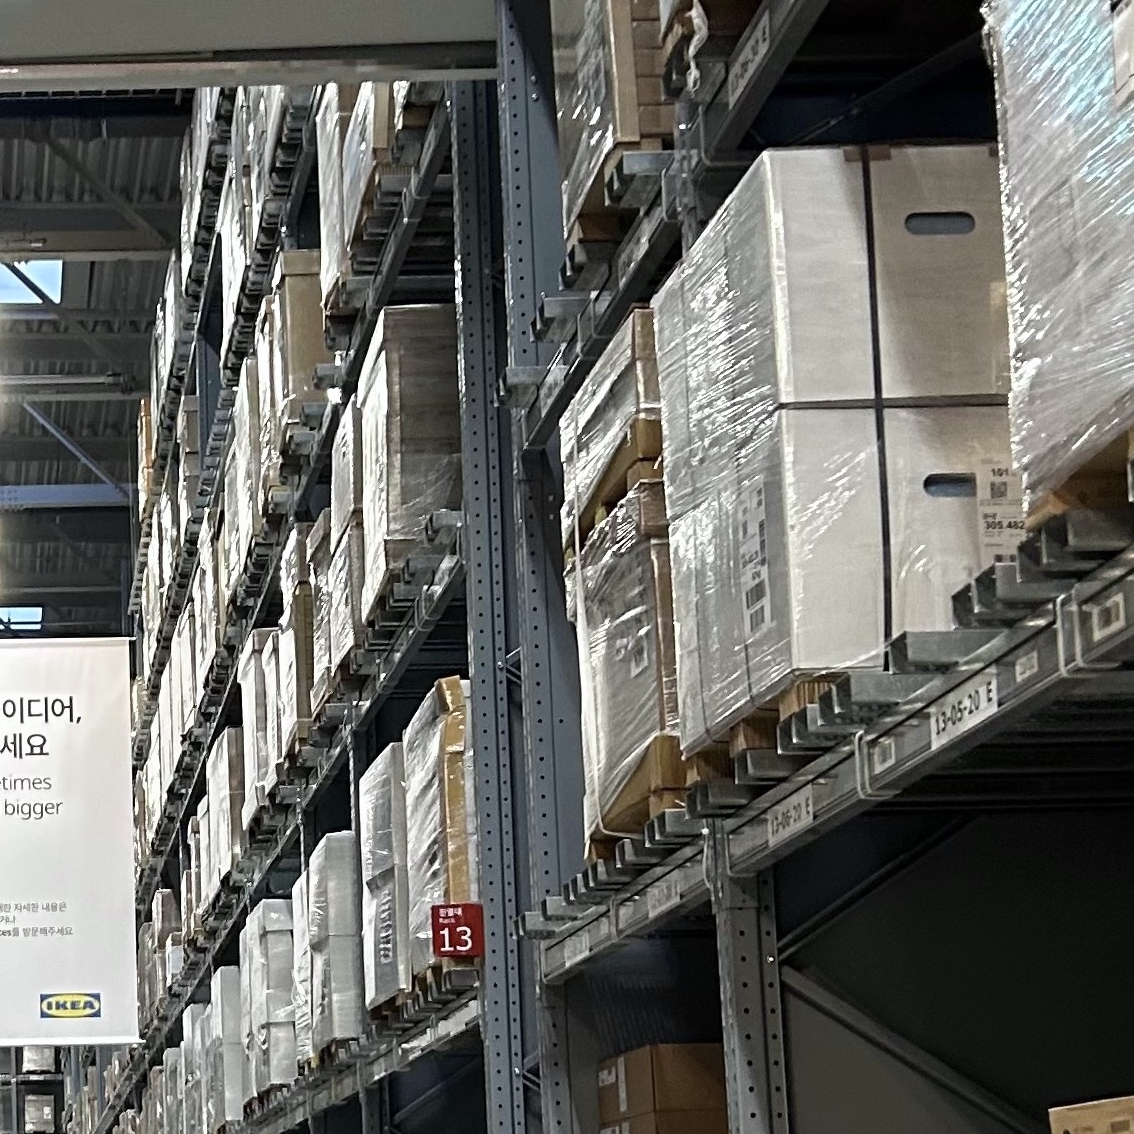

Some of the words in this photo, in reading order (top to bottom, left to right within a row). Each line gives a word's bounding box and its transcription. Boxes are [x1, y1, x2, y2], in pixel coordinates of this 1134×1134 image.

[935, 689, 980, 735] 13-05-20
[986, 681, 993, 702] E
[4, 799, 63, 821] bigger
[439, 926, 472, 951] 13
